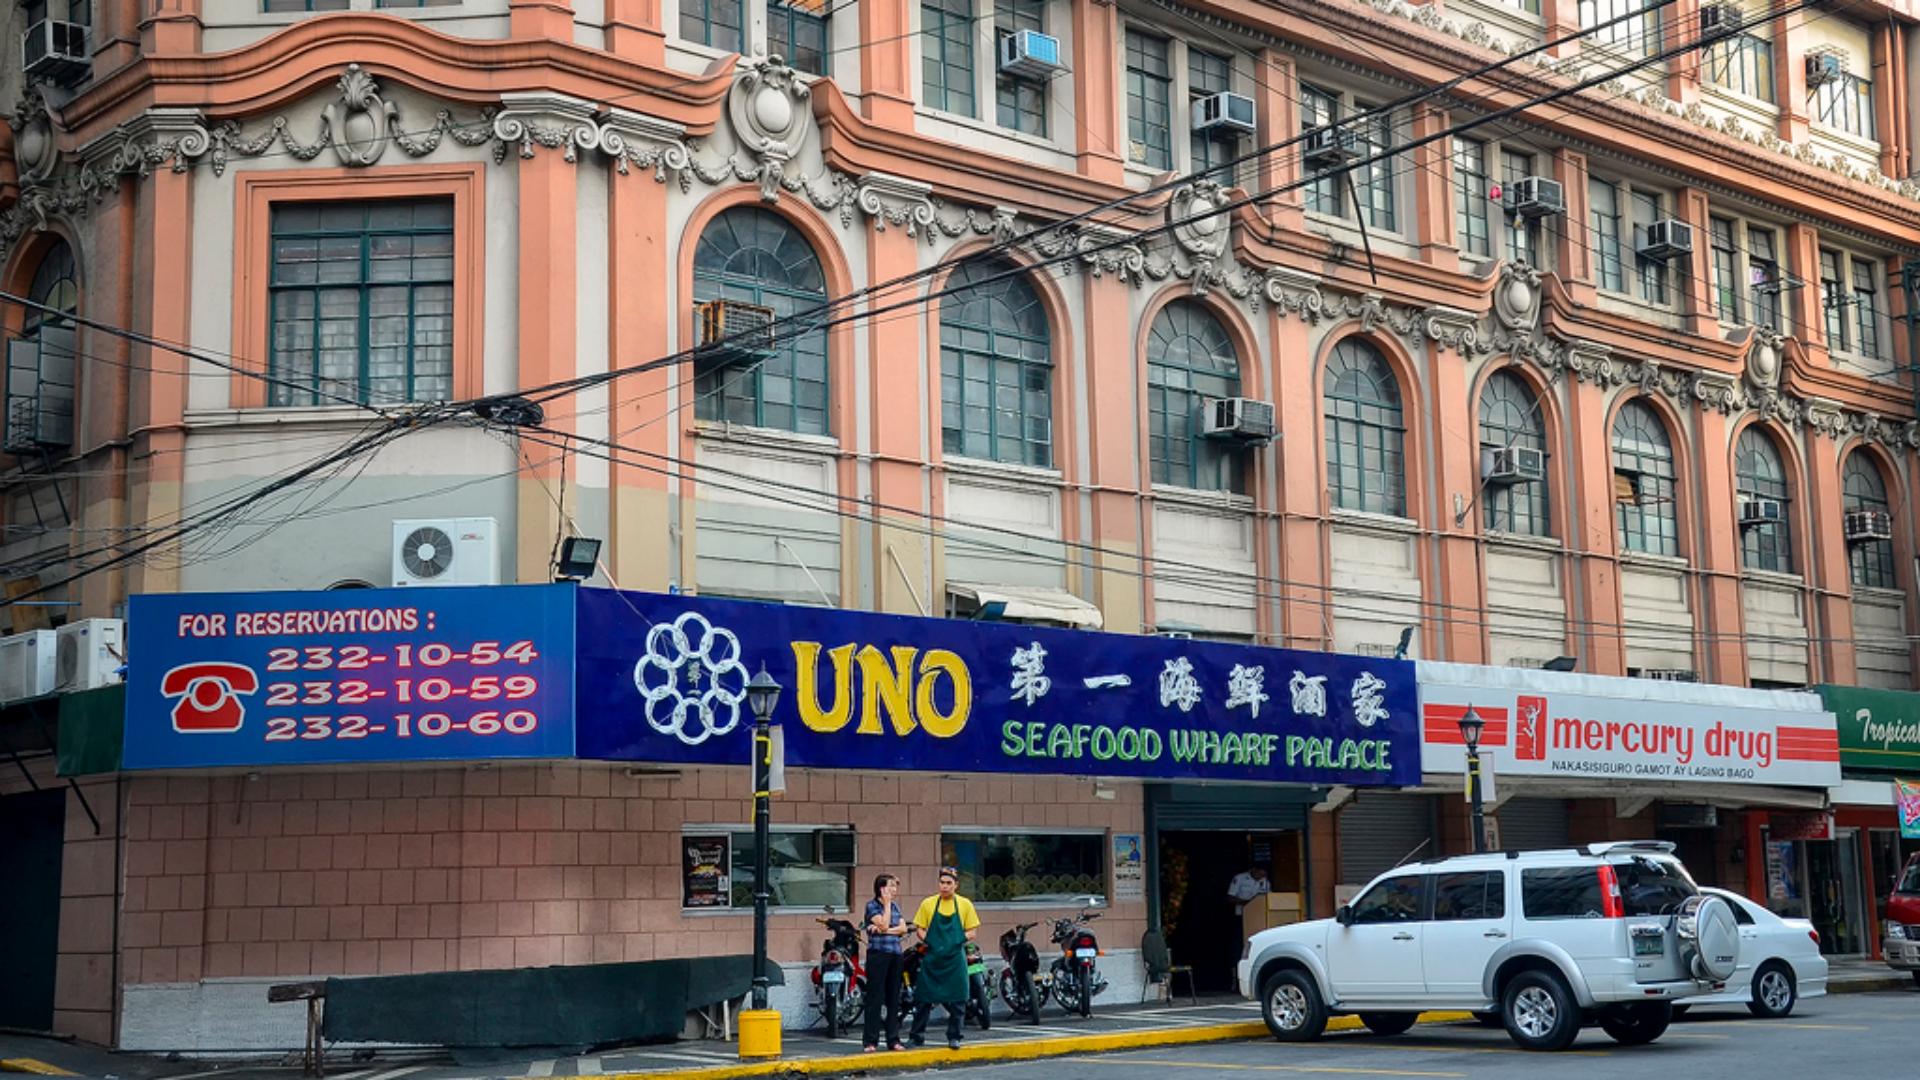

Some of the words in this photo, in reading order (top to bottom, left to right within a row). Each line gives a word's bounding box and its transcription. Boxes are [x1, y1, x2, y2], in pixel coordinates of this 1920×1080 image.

[178, 613, 227, 638] FOR
[235, 608, 419, 636] RESERVATIONS
[266, 640, 539, 671] 232-10-54
[265, 675, 538, 707] 232-10-59
[791, 641, 973, 738] UNO
[264, 710, 538, 742] 232-10-60
[1001, 720, 1163, 763] SEAFOOD
[1169, 729, 1279, 766] WHARF
[1285, 735, 1393, 771] PALACE
[1553, 717, 1694, 764] mercury
[1704, 721, 1772, 768] drug
[1551, 760, 1633, 774] NAKASISIGURO
[1634, 764, 1671, 776] GAMOT
[1673, 765, 1686, 775] AY
[1688, 766, 1725, 778] LAGING
[1726, 767, 1754, 779] BAGO
